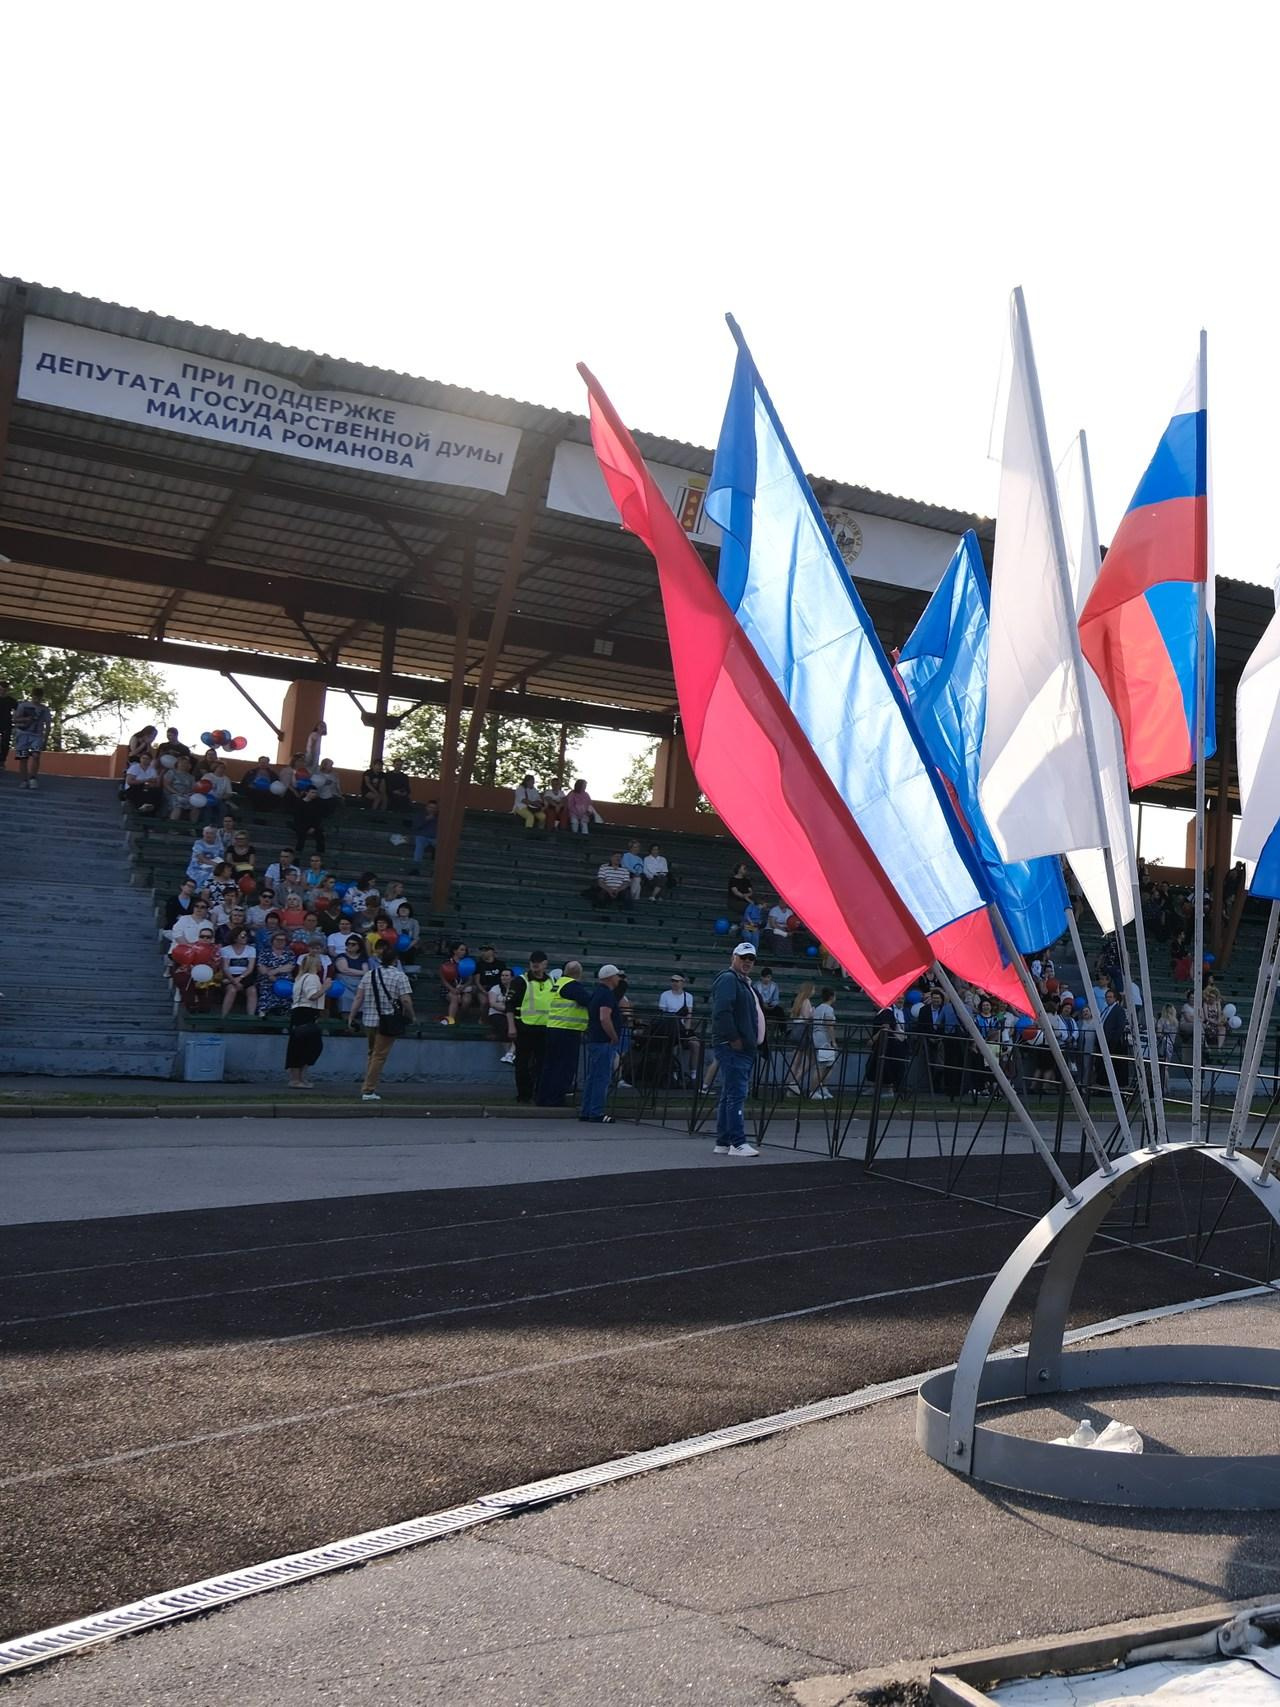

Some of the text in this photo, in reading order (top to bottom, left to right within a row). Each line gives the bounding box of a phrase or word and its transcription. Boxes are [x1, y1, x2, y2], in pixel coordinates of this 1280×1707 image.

[35, 352, 504, 466] ДЕПУТАТА ГОСУДАРСТВЕННОЙ ДУМЫ
[181, 363, 397, 425] ПРИ ПОДДЕРЖКЕ
[145, 398, 415, 469] МИХАИЛА РОМАНОВА
